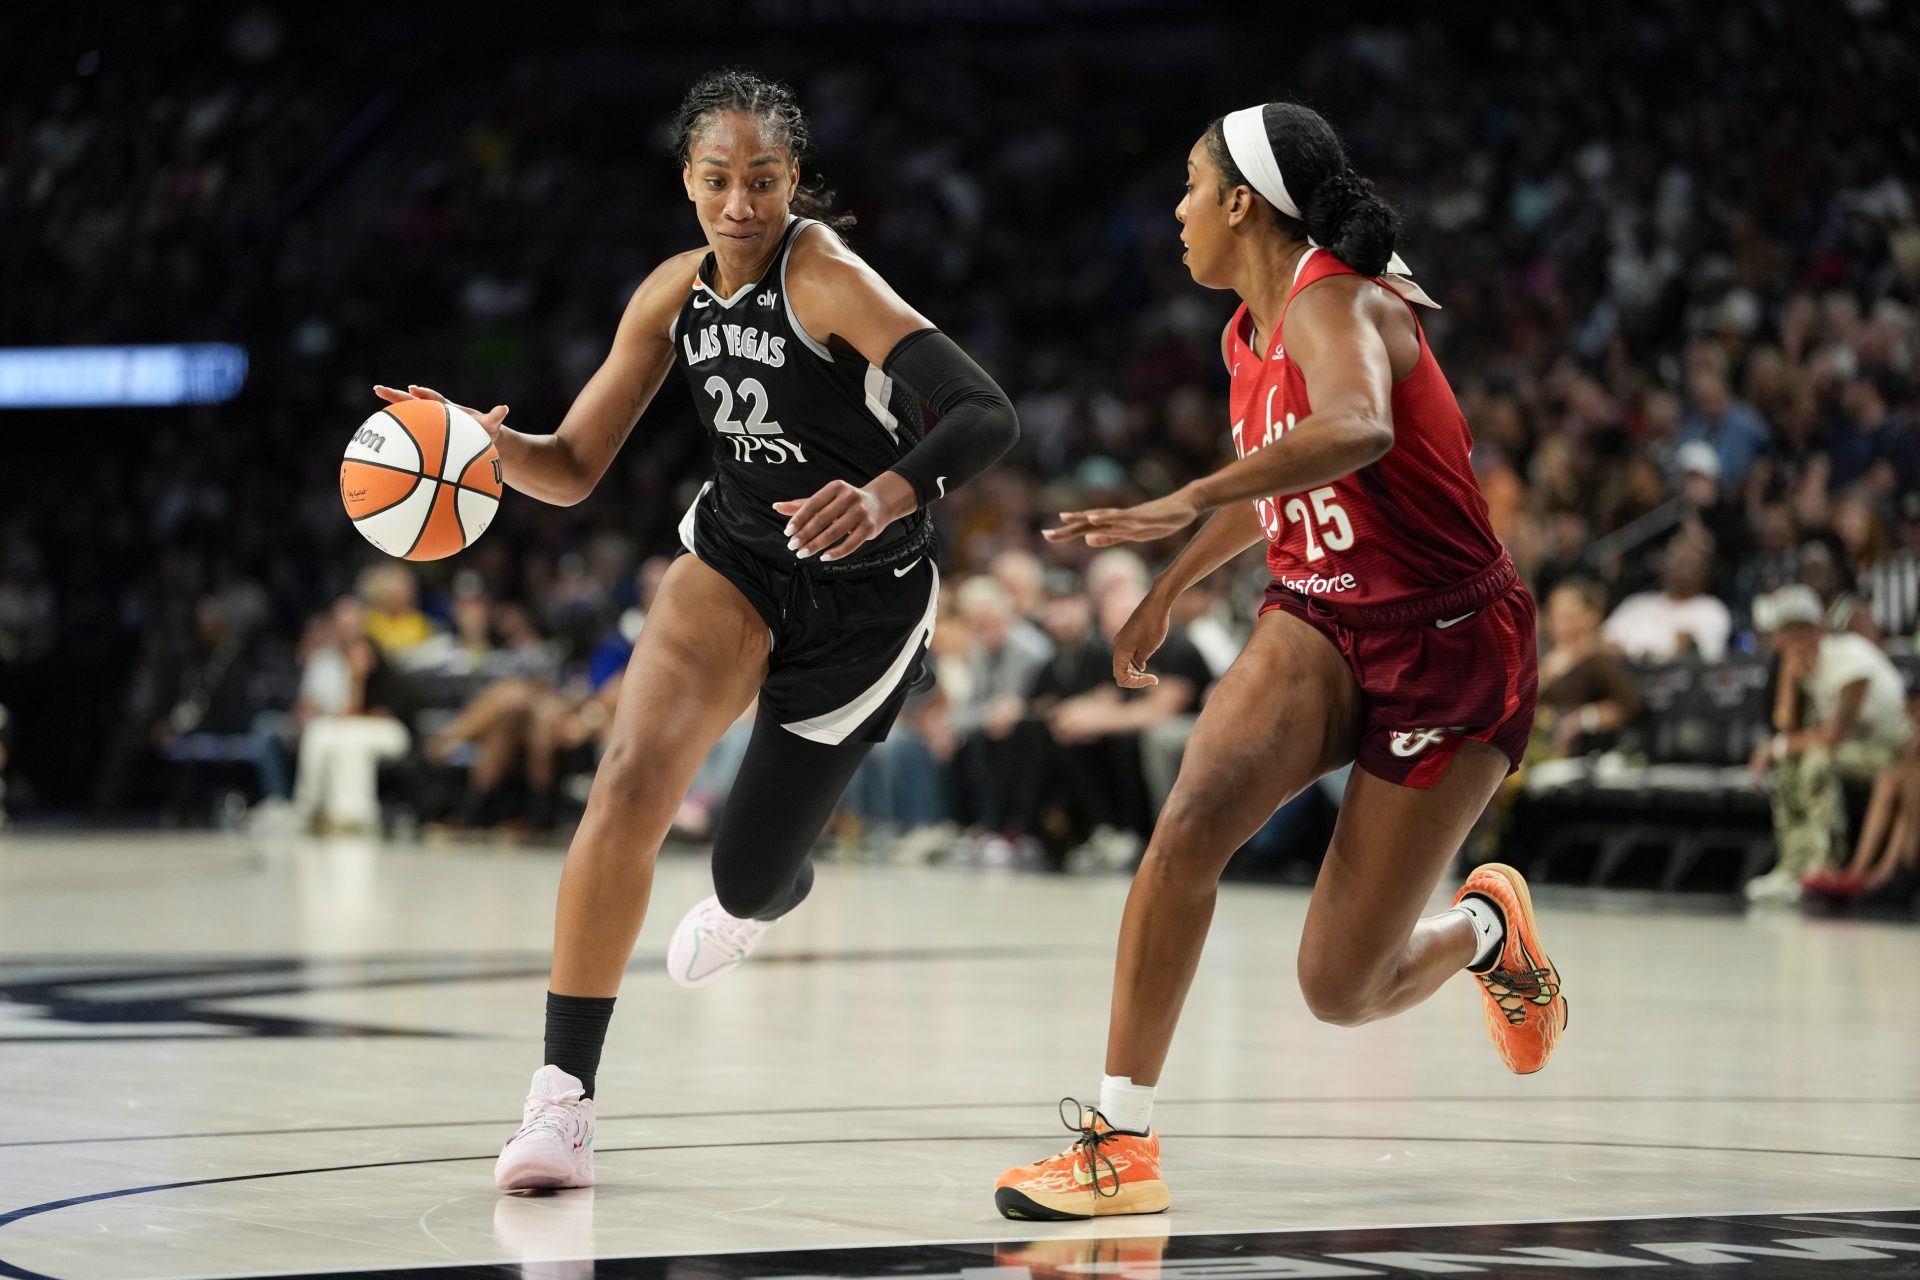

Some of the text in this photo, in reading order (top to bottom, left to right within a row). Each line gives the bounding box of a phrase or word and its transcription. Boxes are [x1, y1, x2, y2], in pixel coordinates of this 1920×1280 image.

[683, 324, 787, 368] LAS VEGAS
[703, 375, 785, 435] 22
[1285, 486, 1355, 563] 25
